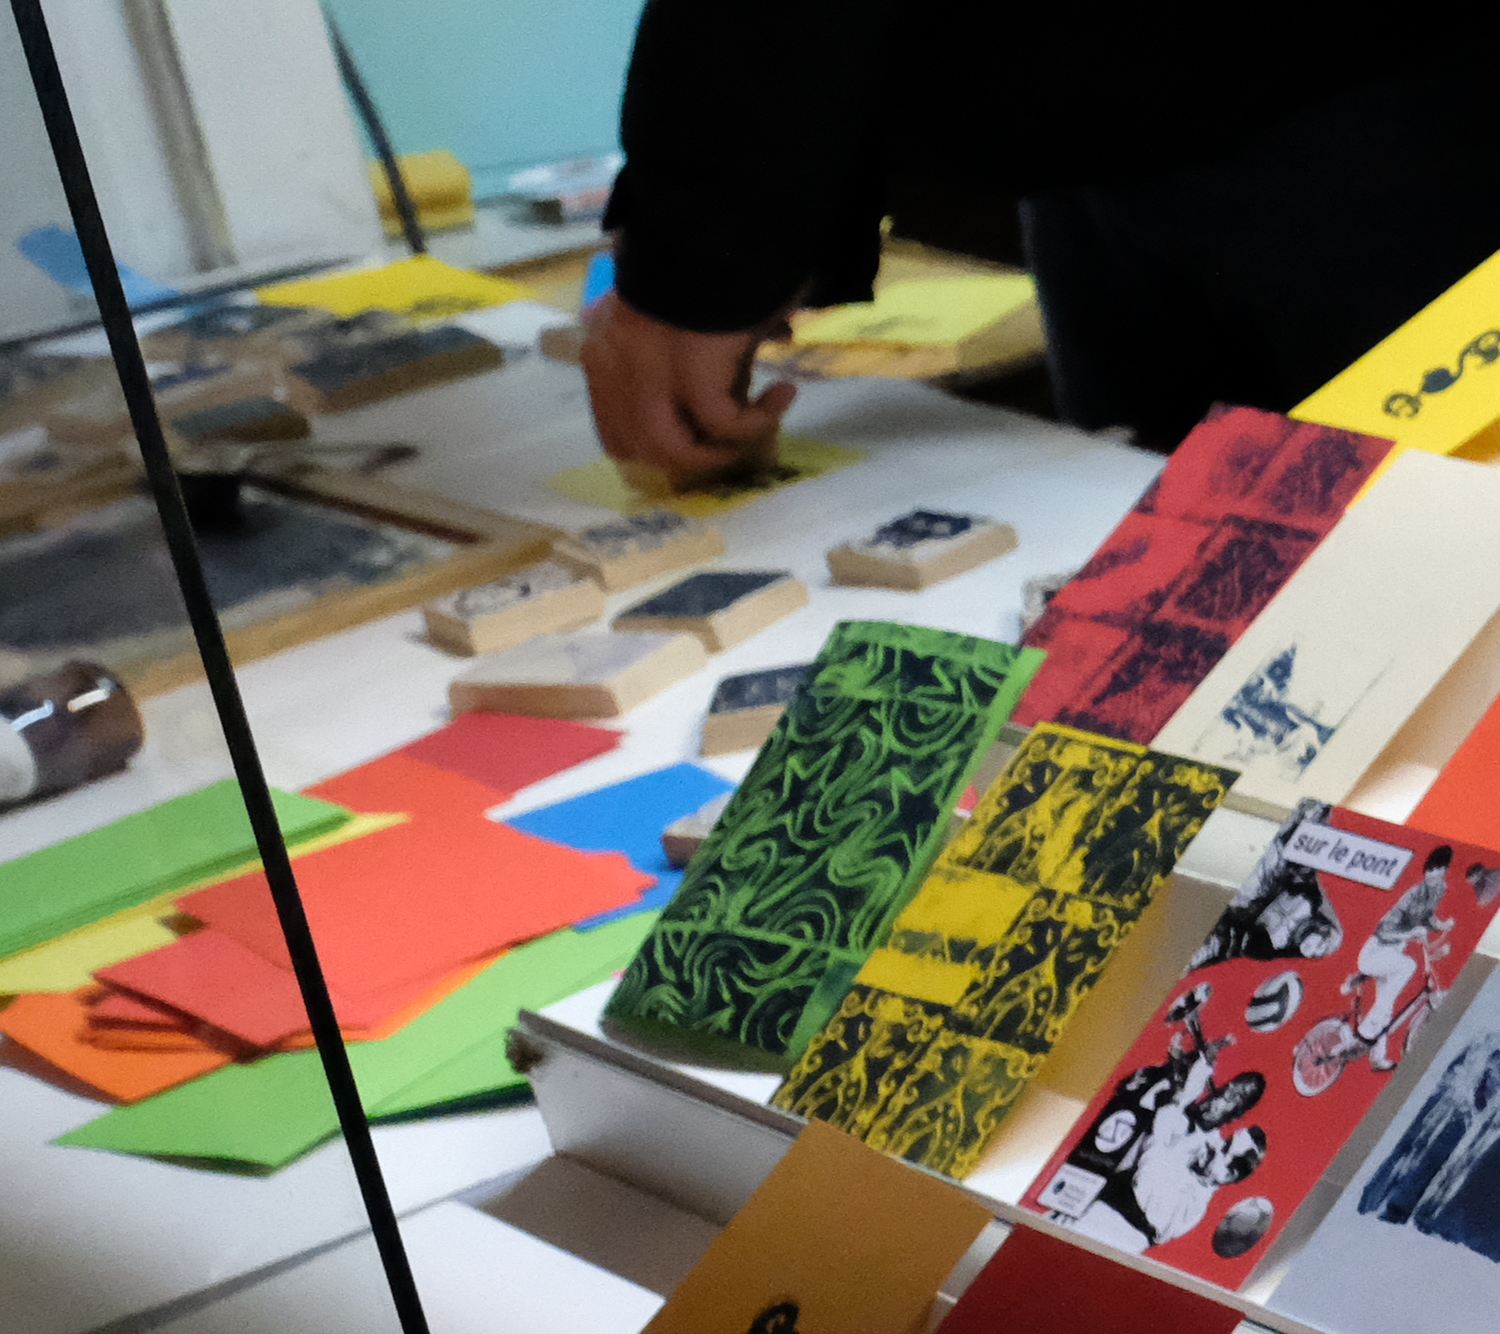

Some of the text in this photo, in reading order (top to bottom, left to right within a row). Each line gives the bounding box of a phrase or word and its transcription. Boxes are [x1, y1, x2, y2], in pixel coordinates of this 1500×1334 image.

[1292, 833, 1399, 878] sur le pont
